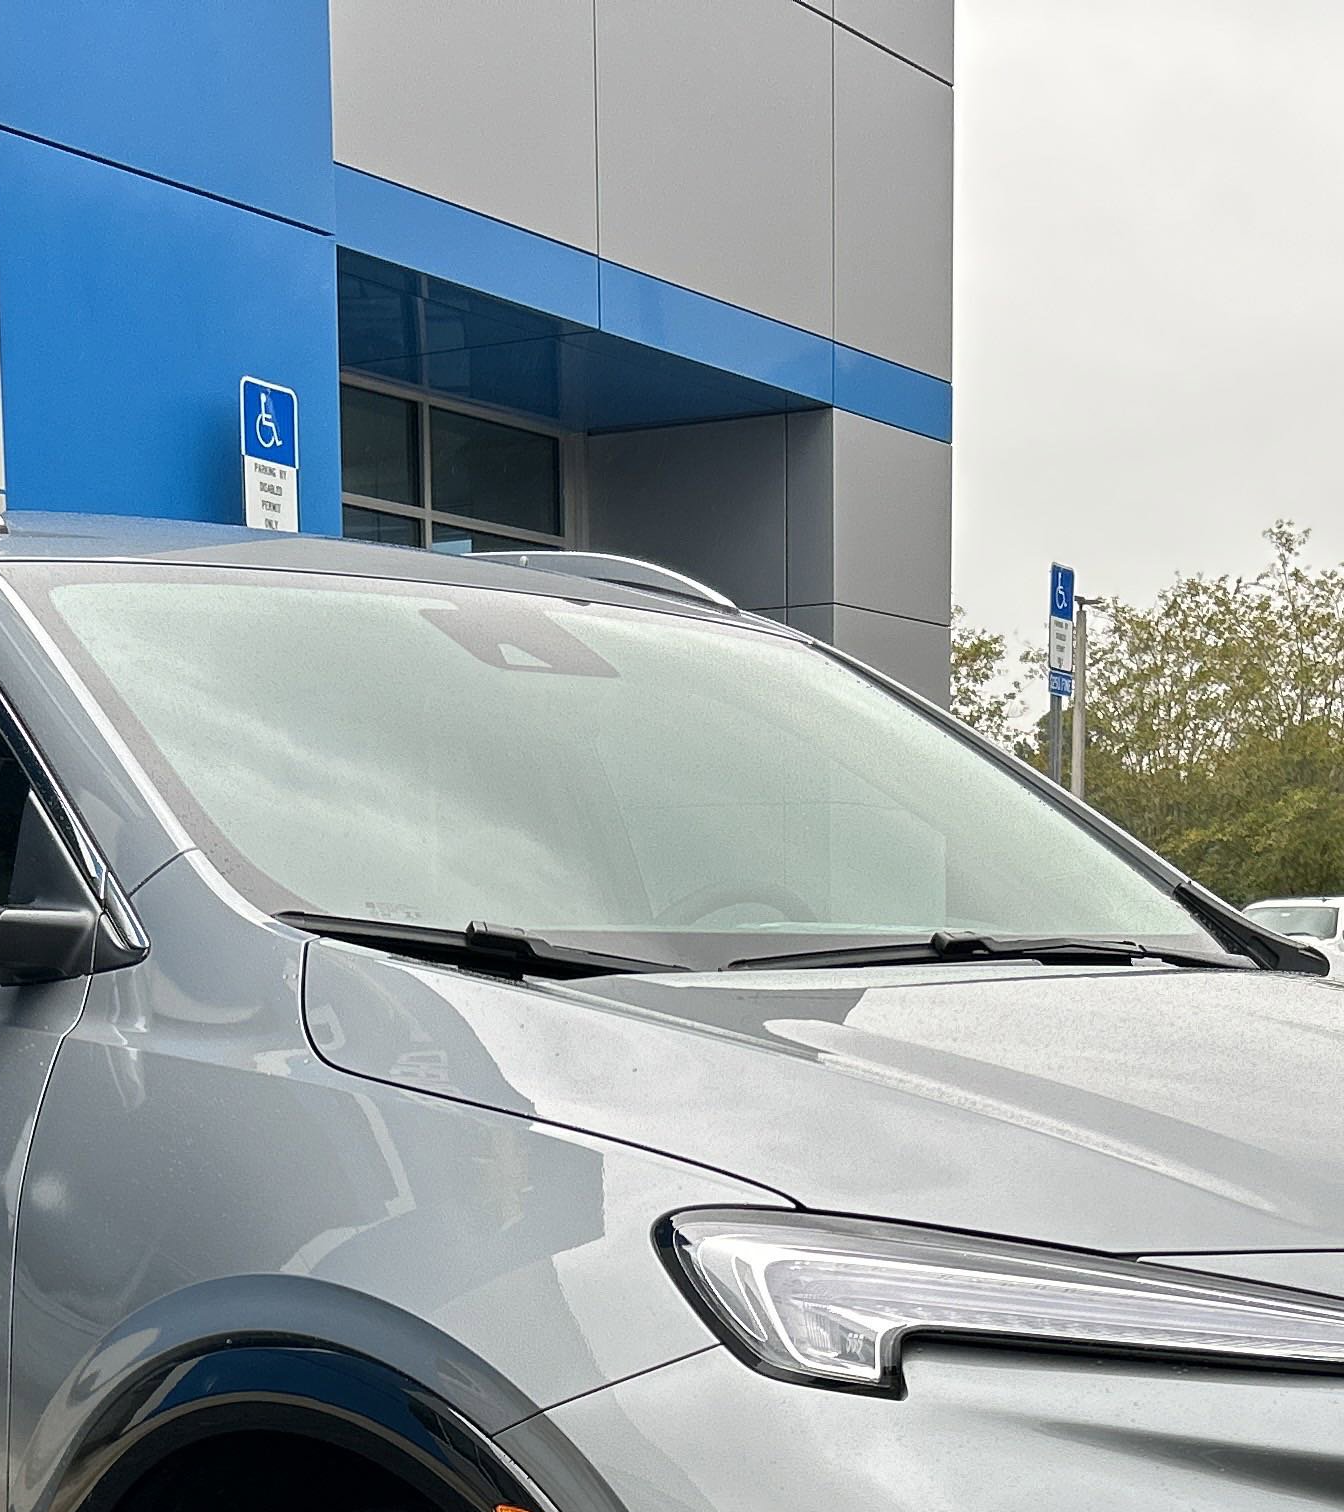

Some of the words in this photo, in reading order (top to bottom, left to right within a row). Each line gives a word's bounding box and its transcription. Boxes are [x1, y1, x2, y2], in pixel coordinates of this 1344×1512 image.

[254, 462, 276, 478] PARKING
[259, 481, 283, 497] DISABLED
[261, 499, 281, 514] PERMIT
[264, 518, 279, 530] ONLY
